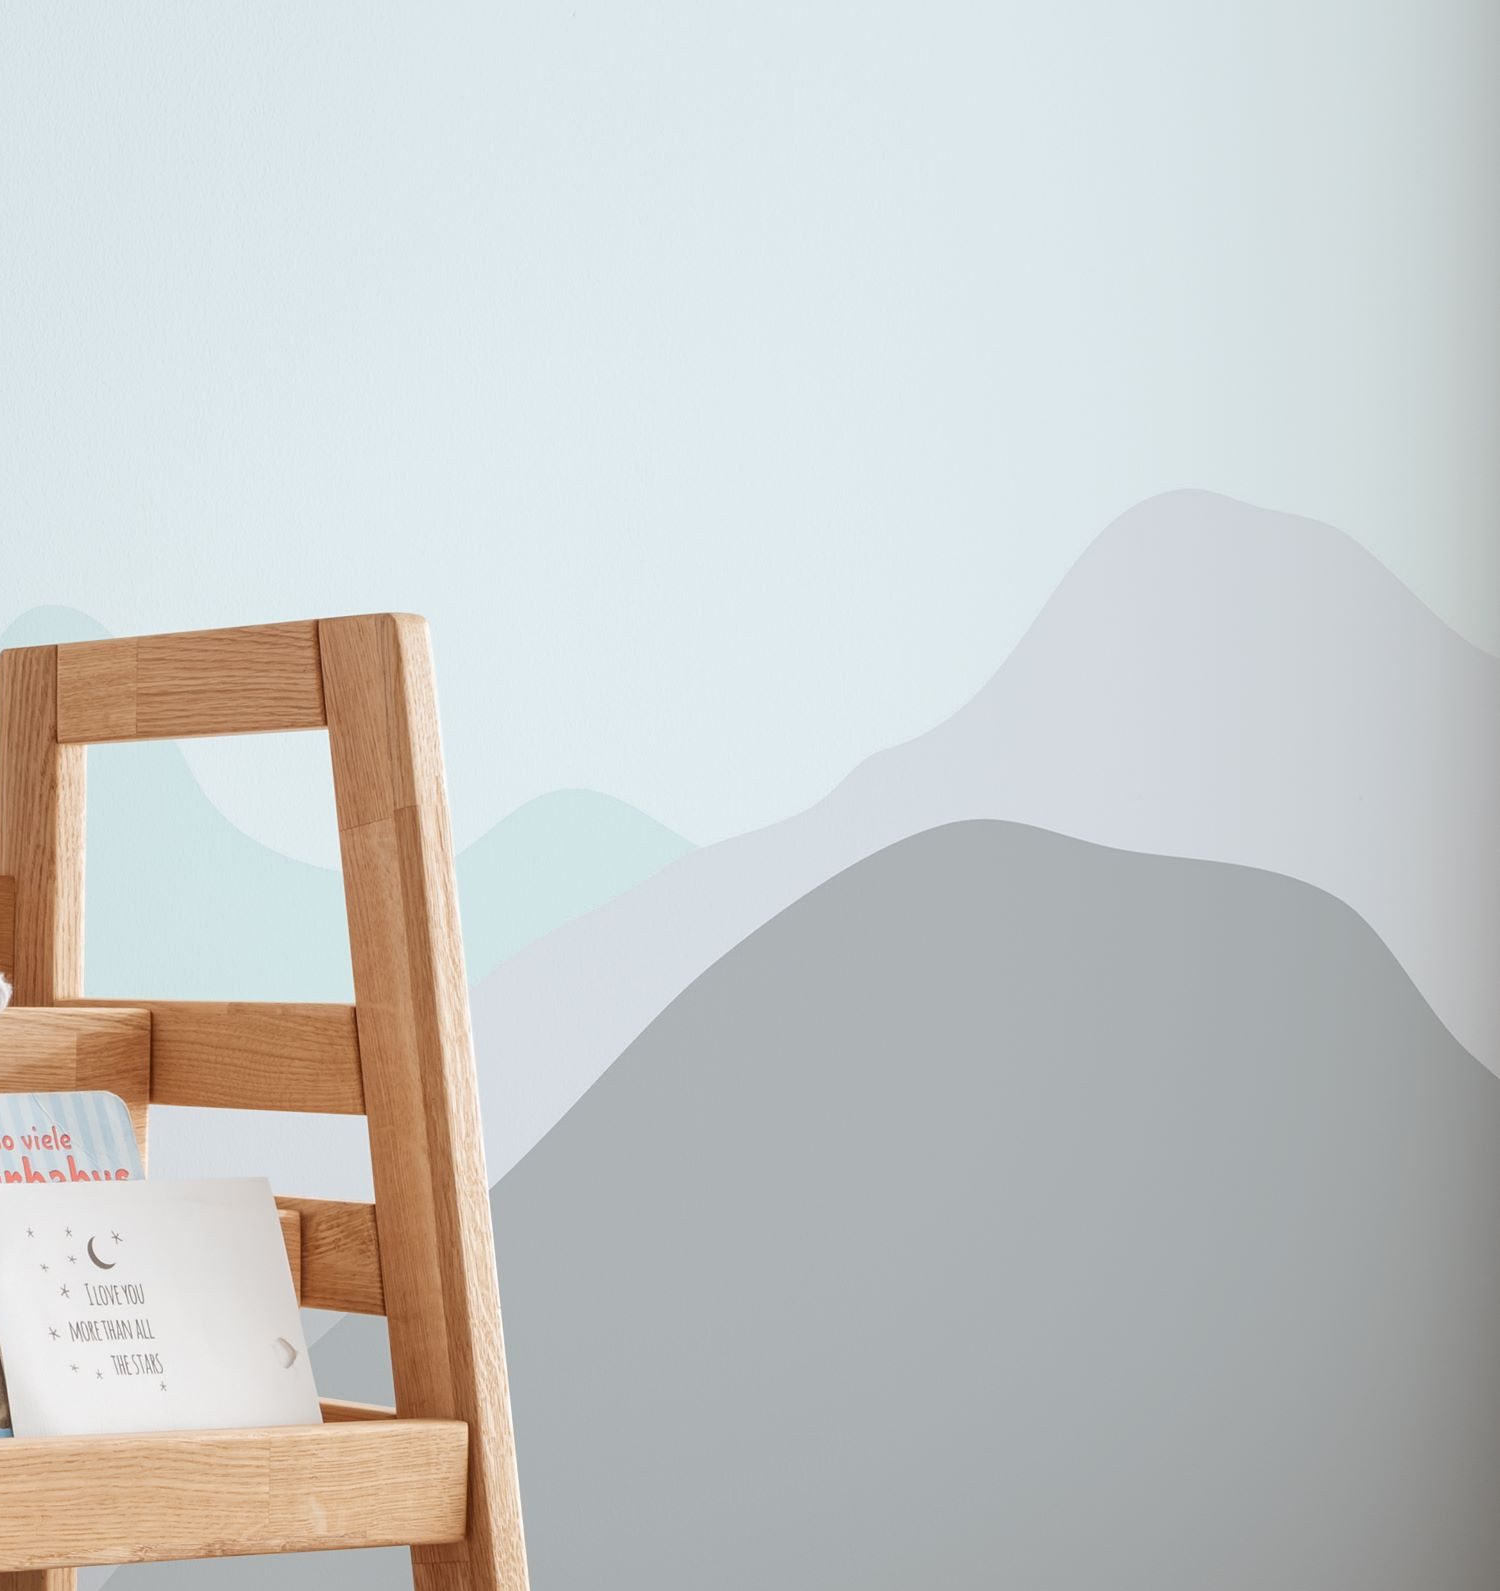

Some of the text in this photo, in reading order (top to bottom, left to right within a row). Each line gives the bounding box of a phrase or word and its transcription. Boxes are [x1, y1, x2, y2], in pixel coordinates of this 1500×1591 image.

[20, 1125, 73, 1151] viele
[84, 1282, 145, 1306] I LOVE YOU
[68, 1318, 156, 1342] MORE THAN ALL
[110, 1353, 164, 1376] THE STARS
